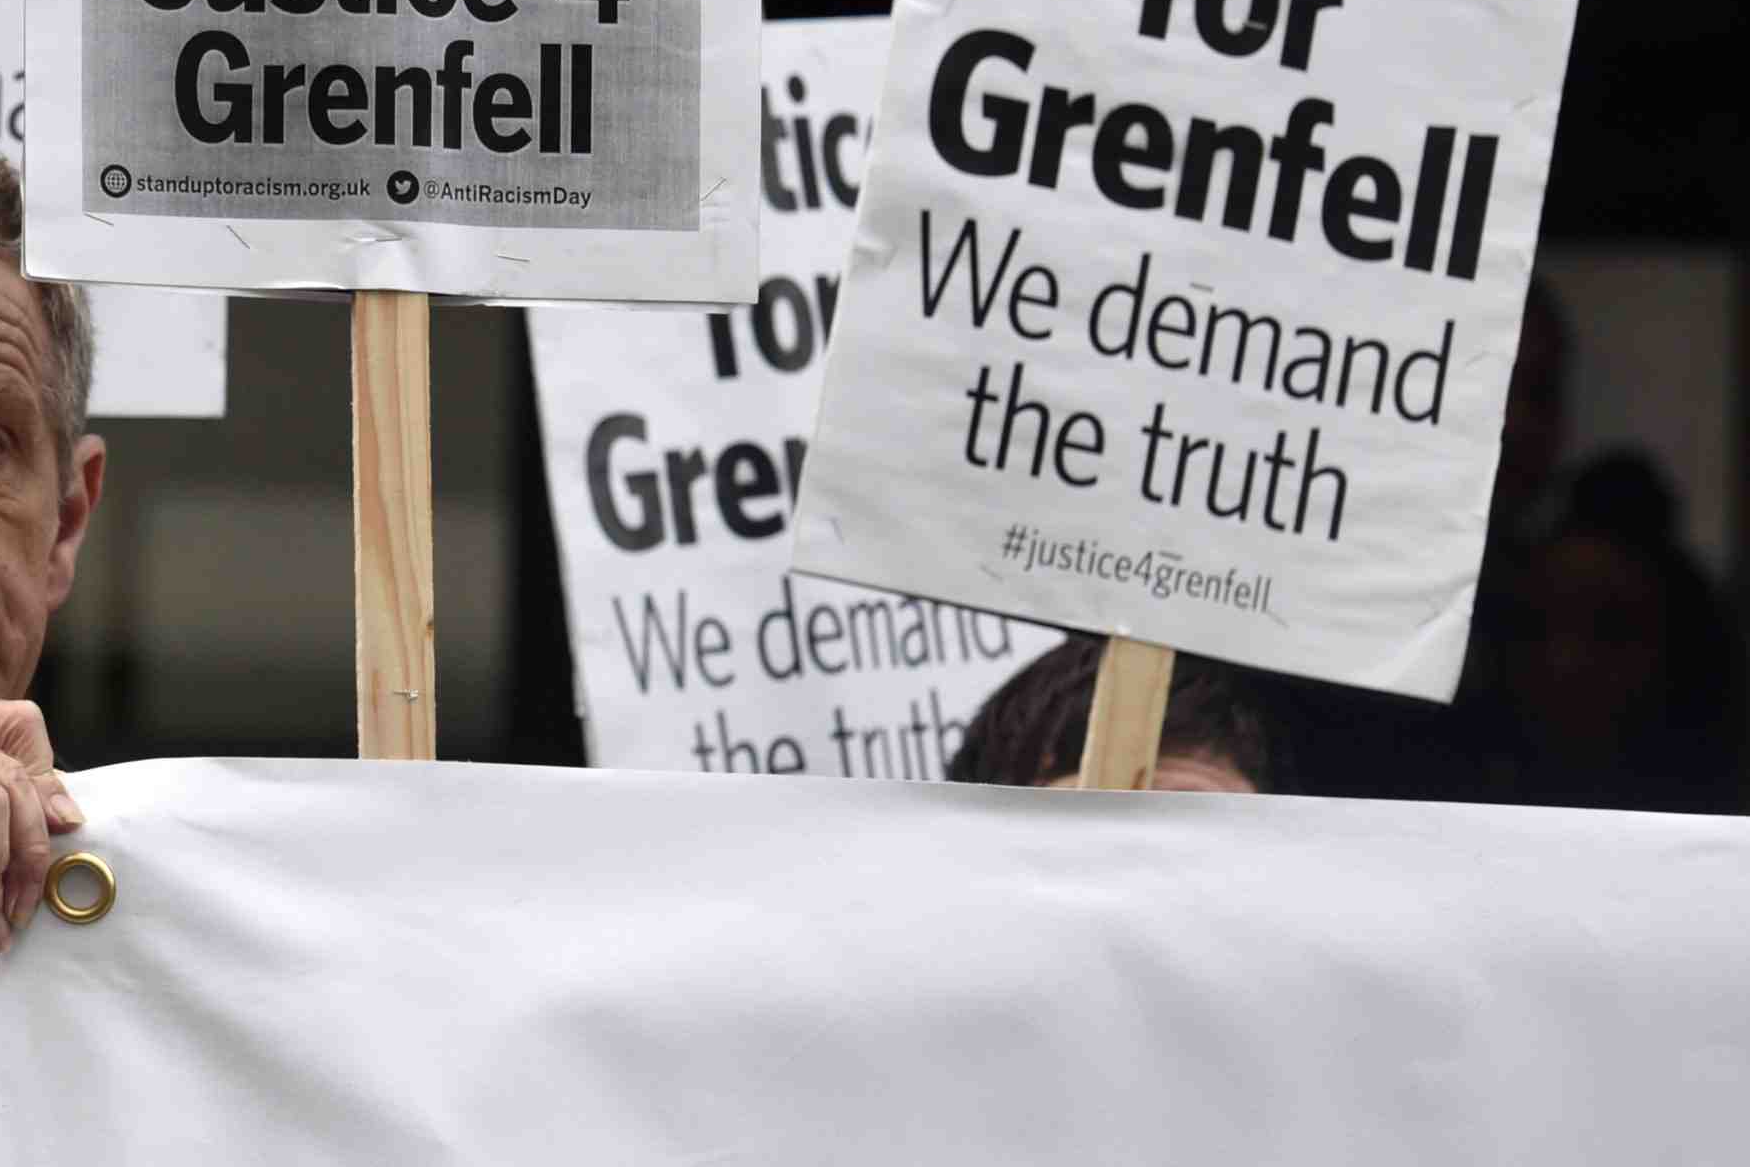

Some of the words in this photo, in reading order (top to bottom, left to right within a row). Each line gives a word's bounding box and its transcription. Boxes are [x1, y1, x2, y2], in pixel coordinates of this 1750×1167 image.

[174, 30, 593, 154] Grenfell
[760, 75, 871, 212] tic
[137, 172, 371, 199] standuptoracism.org.uk
[424, 180, 592, 209] @AntiRacismDay
[929, 28, 1500, 281] Grenfell
[919, 209, 1060, 342] We
[1089, 251, 1455, 426] demand
[963, 364, 1105, 487] the
[1140, 404, 1348, 541] truth
[1002, 523, 1272, 614] #justice4grenfell
[612, 589, 735, 694] We
